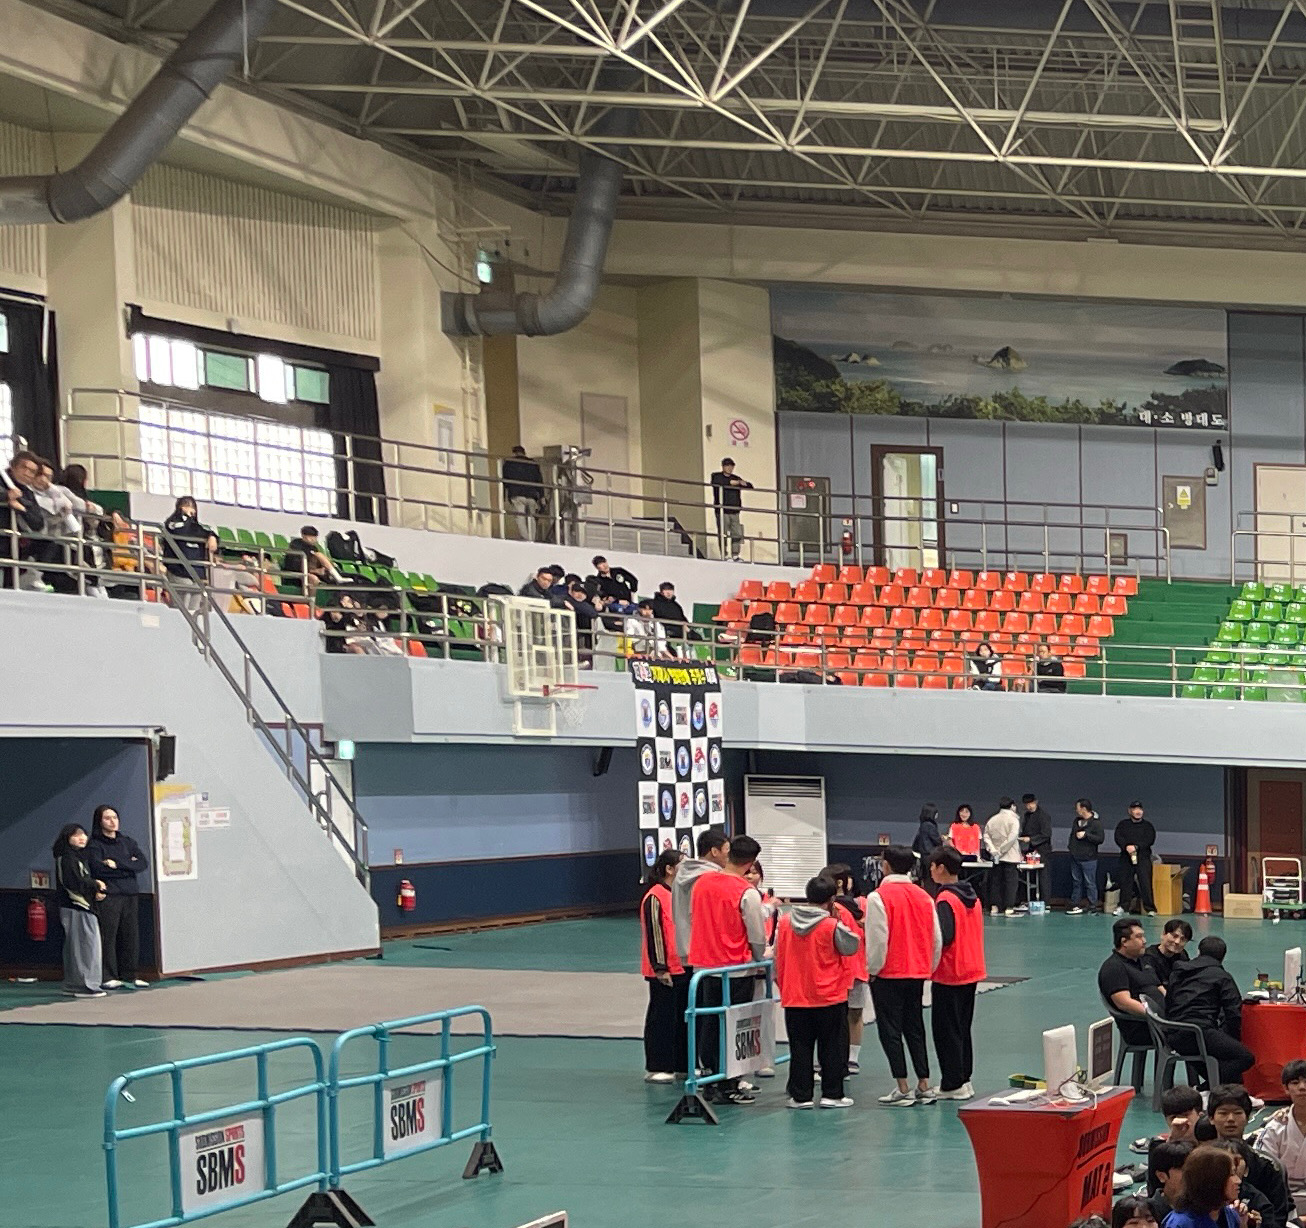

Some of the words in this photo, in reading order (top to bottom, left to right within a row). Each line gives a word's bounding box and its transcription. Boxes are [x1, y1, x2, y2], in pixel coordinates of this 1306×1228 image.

[735, 1029, 761, 1060] SBMS
[391, 1097, 425, 1140] SBMS
[196, 1144, 246, 1195] SBMS
